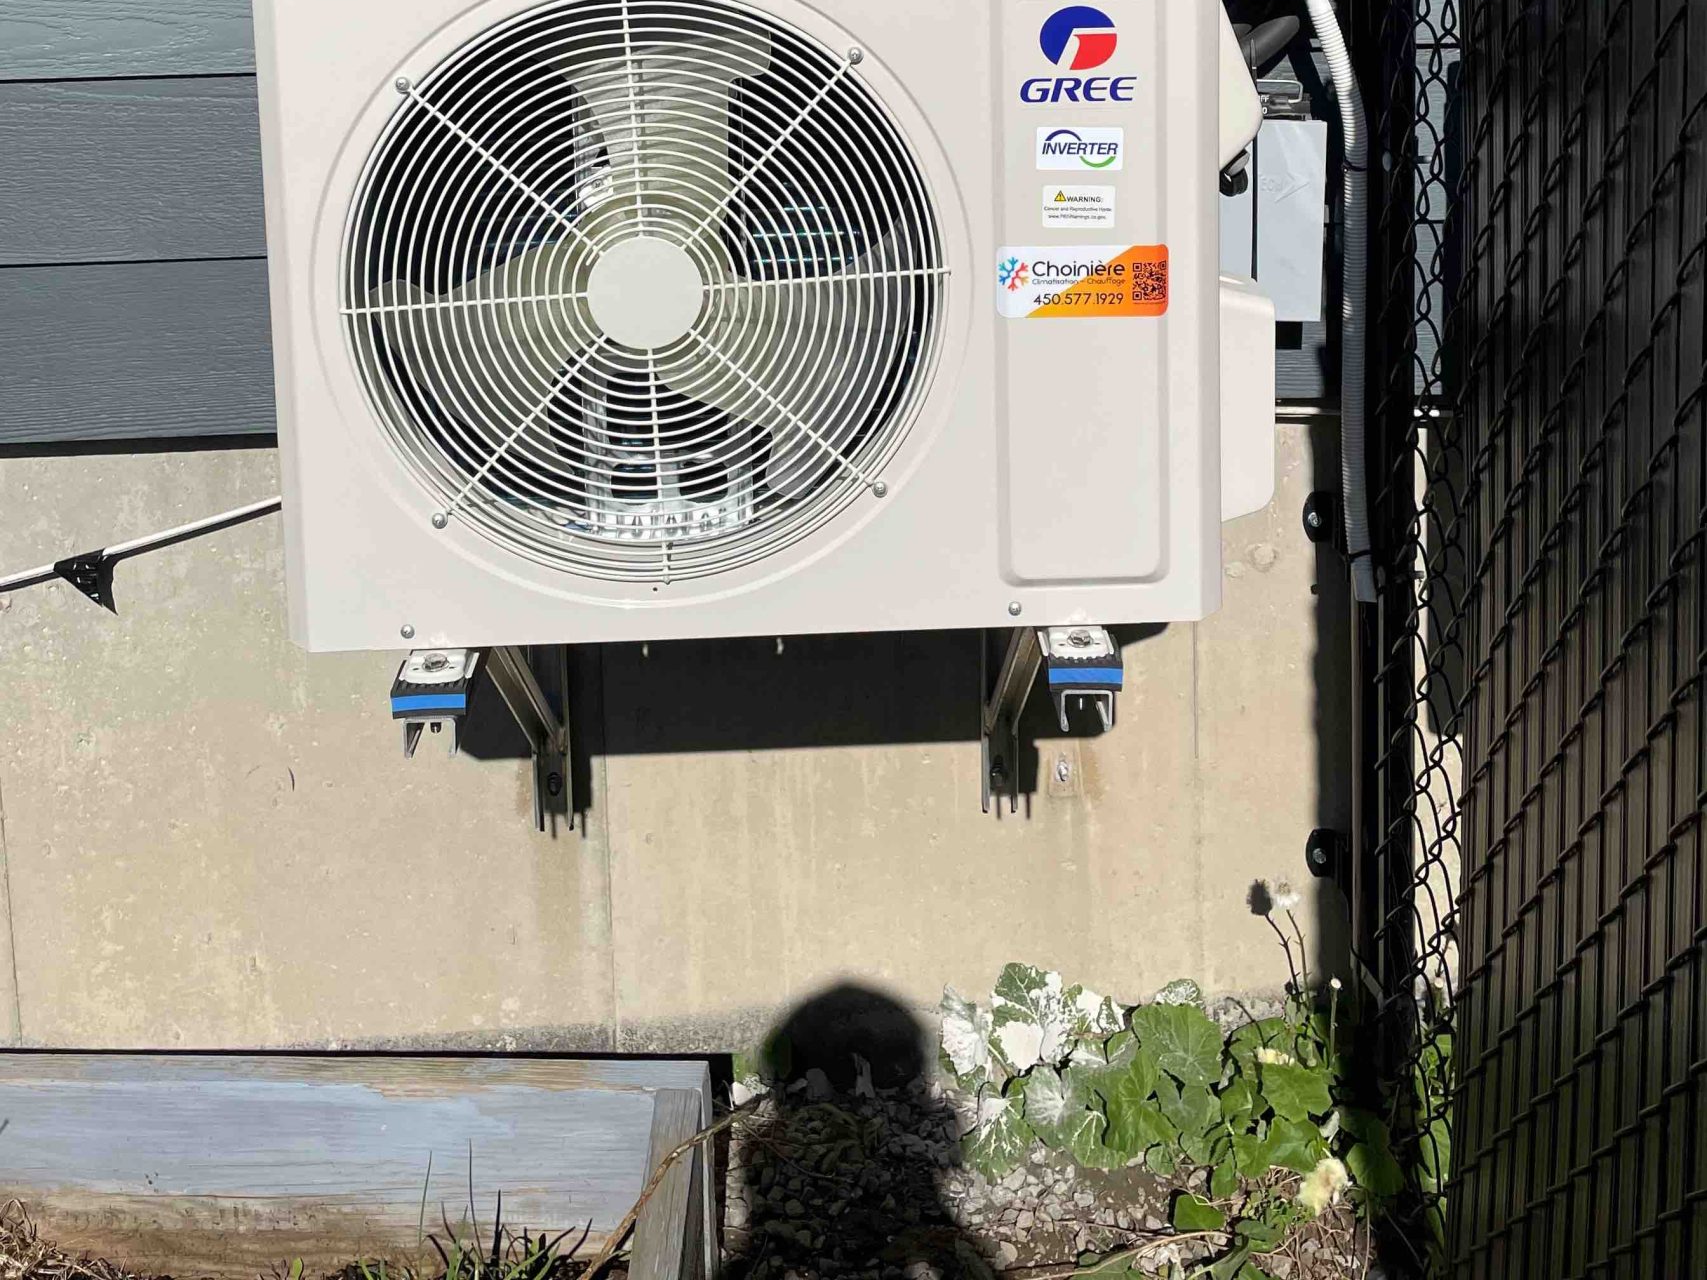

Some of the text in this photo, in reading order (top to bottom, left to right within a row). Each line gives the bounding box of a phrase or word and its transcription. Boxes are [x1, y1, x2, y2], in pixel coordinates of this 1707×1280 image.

[1020, 76, 1137, 103] GREE
[1042, 142, 1118, 155] INVERTER
[1032, 261, 1125, 277] Choinière
[1087, 278, 1126, 287] Chauffage
[1033, 293, 1124, 305] 450.577.1929
